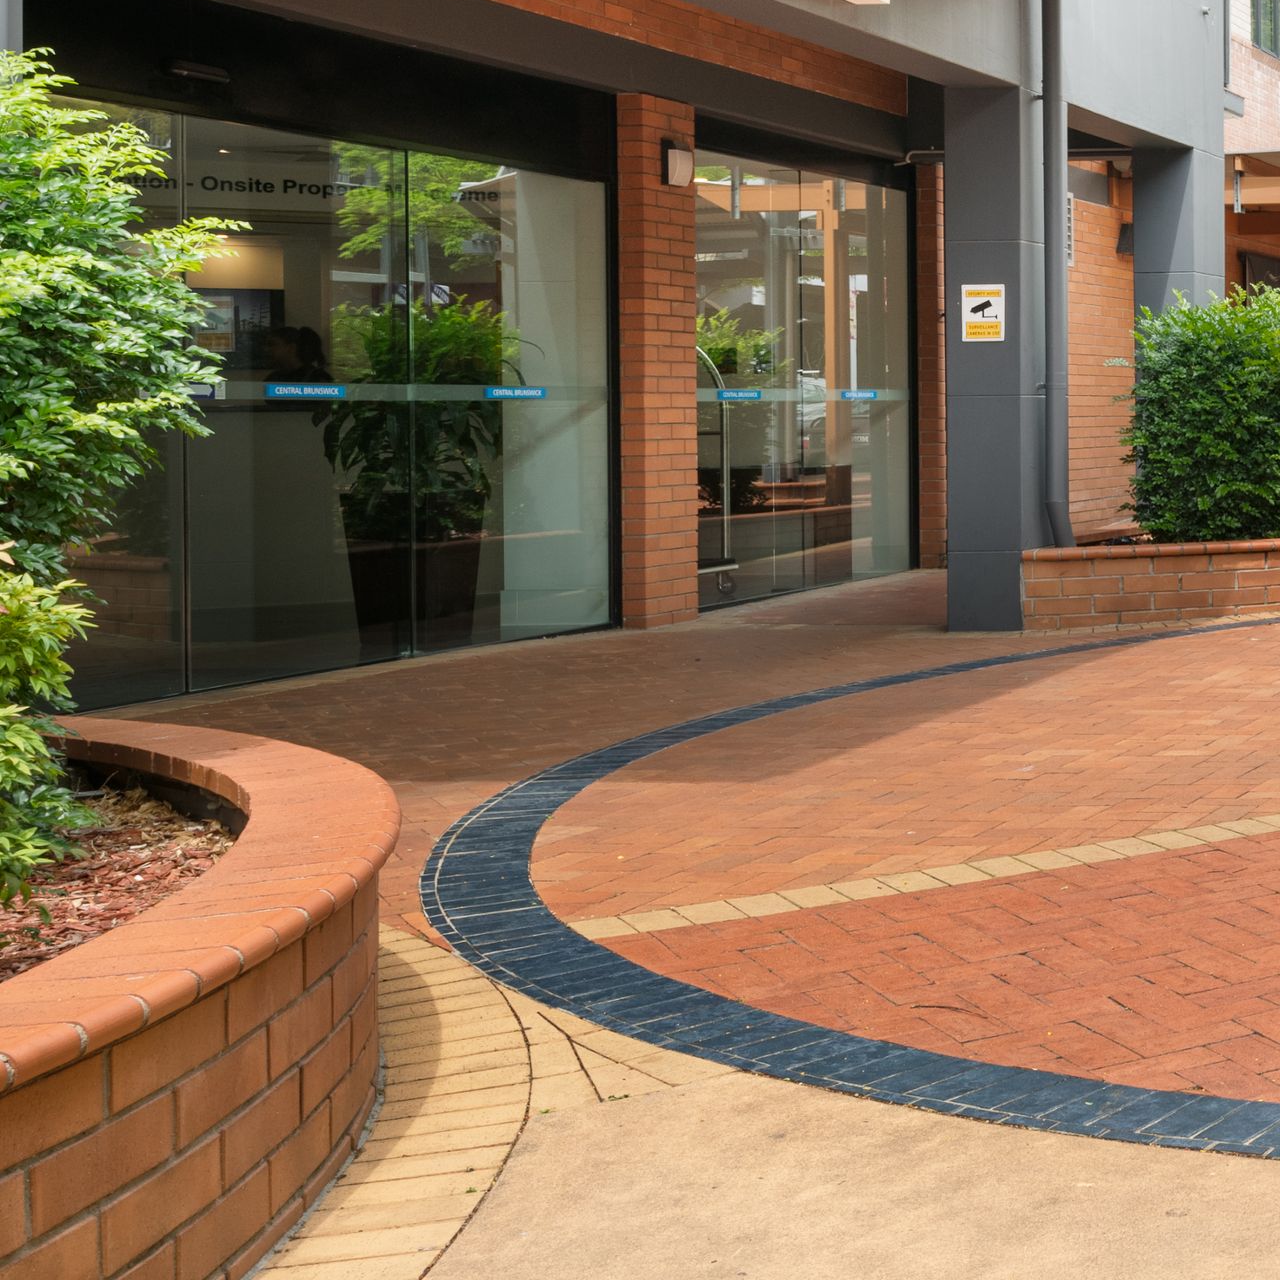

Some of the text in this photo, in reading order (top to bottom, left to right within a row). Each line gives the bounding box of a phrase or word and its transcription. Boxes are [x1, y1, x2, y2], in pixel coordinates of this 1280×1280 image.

[201, 176, 275, 193] Onsite
[274, 385, 339, 396] CENTRAL BRUNSWICK
